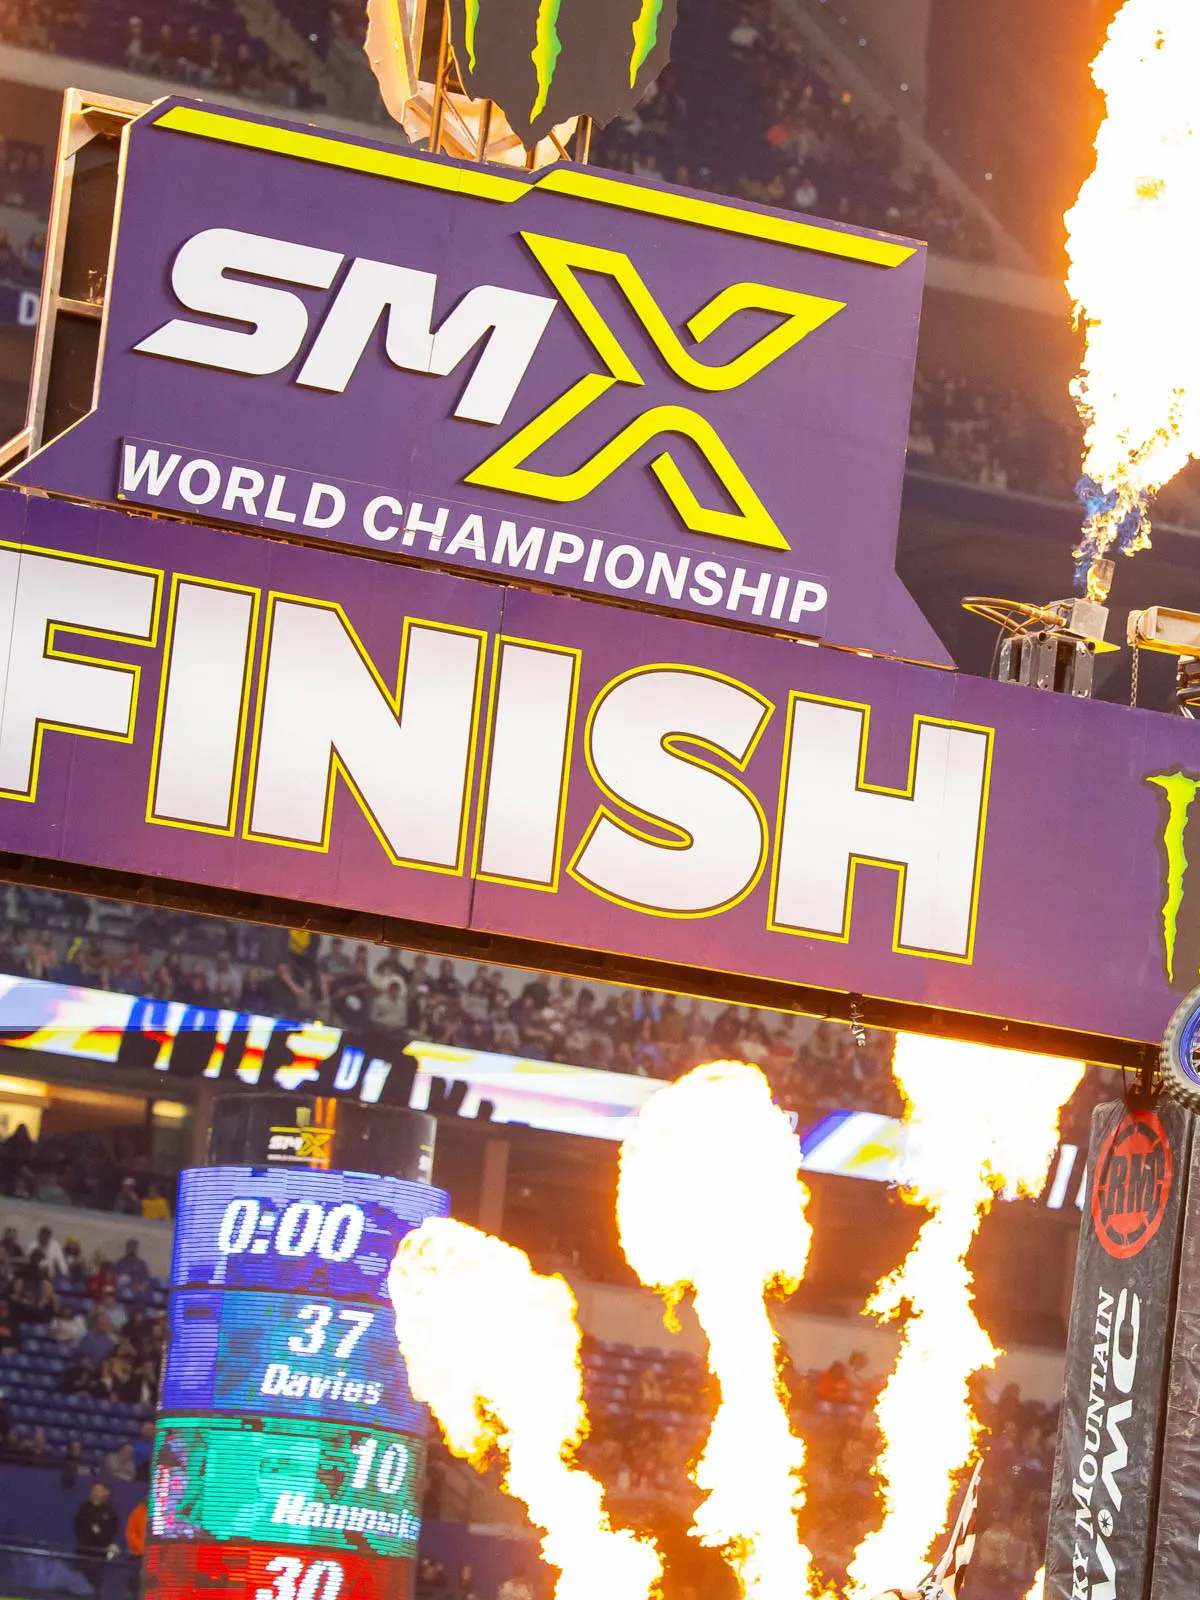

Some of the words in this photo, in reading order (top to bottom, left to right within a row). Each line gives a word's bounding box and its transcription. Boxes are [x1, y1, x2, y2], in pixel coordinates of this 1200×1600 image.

[134, 228, 847, 551] SMX
[123, 445, 346, 529] WORLD
[363, 494, 829, 624] CHAMPIONSHIP
[0, 540, 995, 965] FINISH
[218, 1199, 366, 1262] 0:00
[288, 1304, 374, 1358] 37
[260, 1363, 384, 1405] Davies
[1071, 1287, 1115, 1539] MOUNTAIN
[351, 1438, 408, 1495] 10
[254, 1556, 345, 1600] 30
